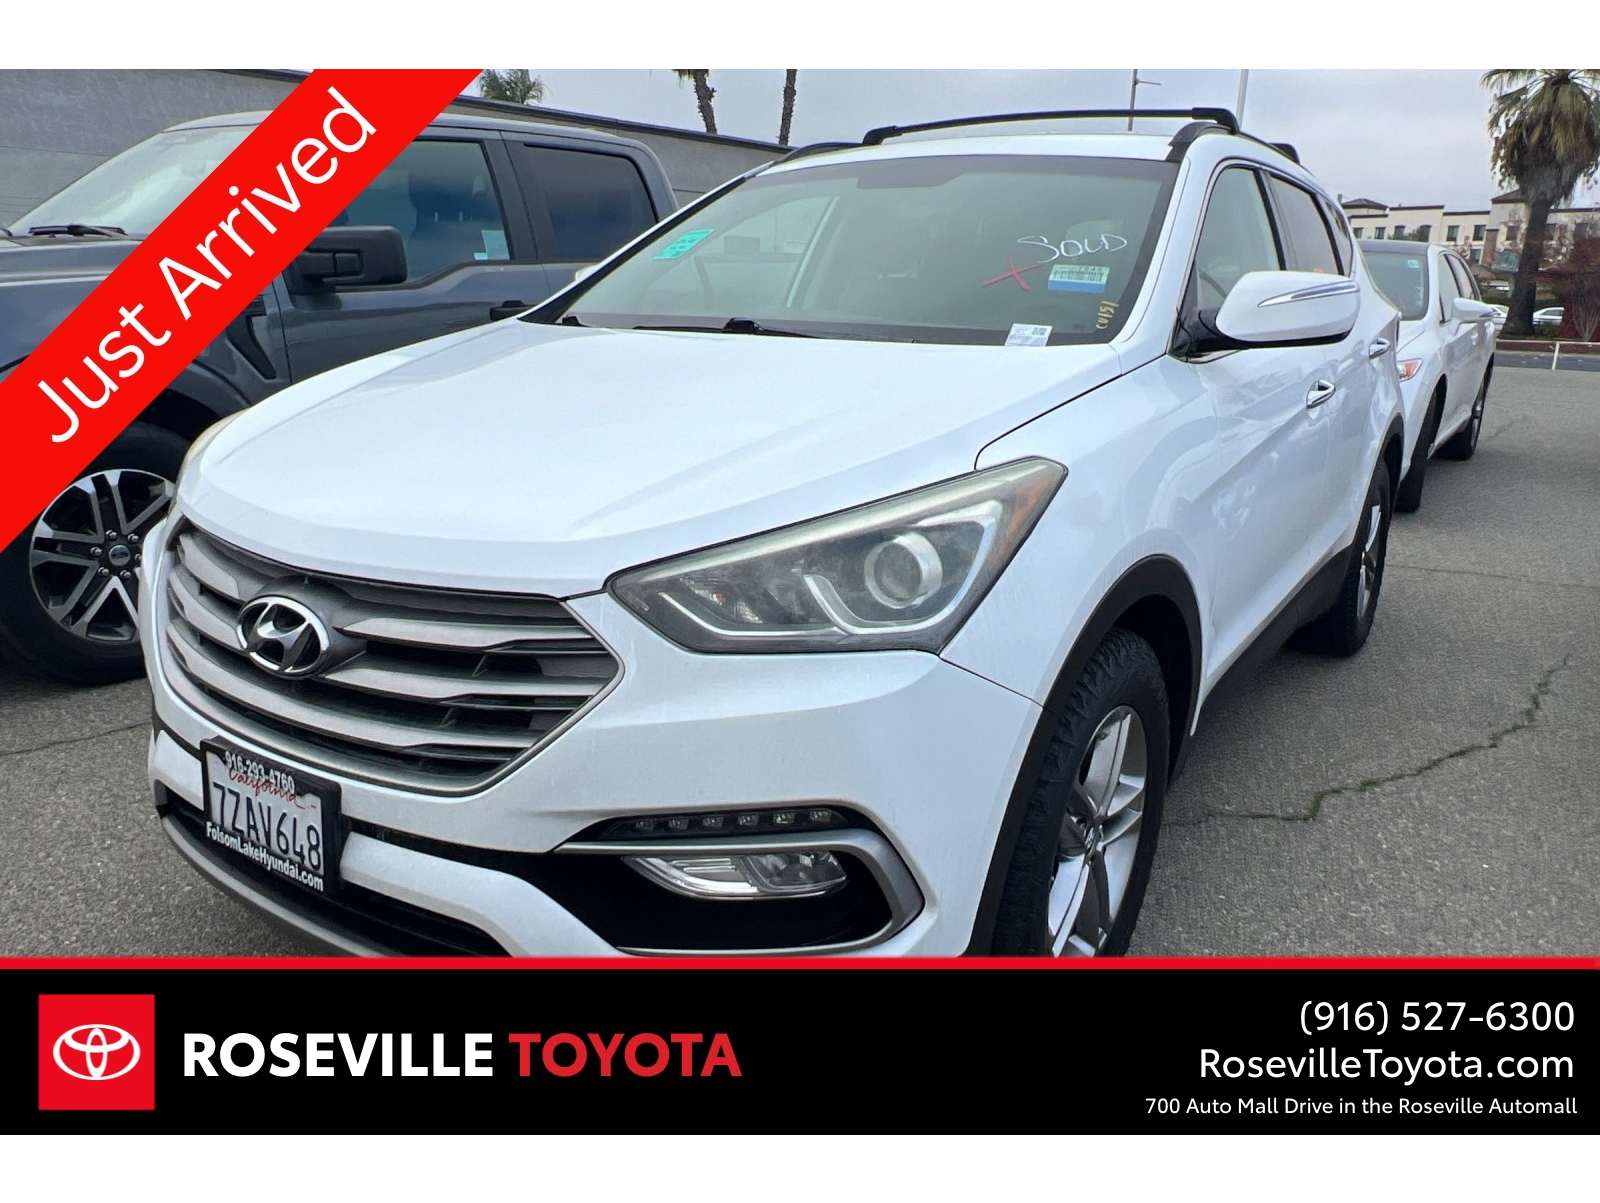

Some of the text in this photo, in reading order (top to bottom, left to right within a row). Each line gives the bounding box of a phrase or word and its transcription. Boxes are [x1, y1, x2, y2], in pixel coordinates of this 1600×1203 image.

[1016, 232, 1129, 264] SOLD
[224, 750, 296, 793] 916-293-4760
[212, 781, 322, 872] 7ZAV648
[206, 821, 324, 892] FolsomLakeHyundai.com
